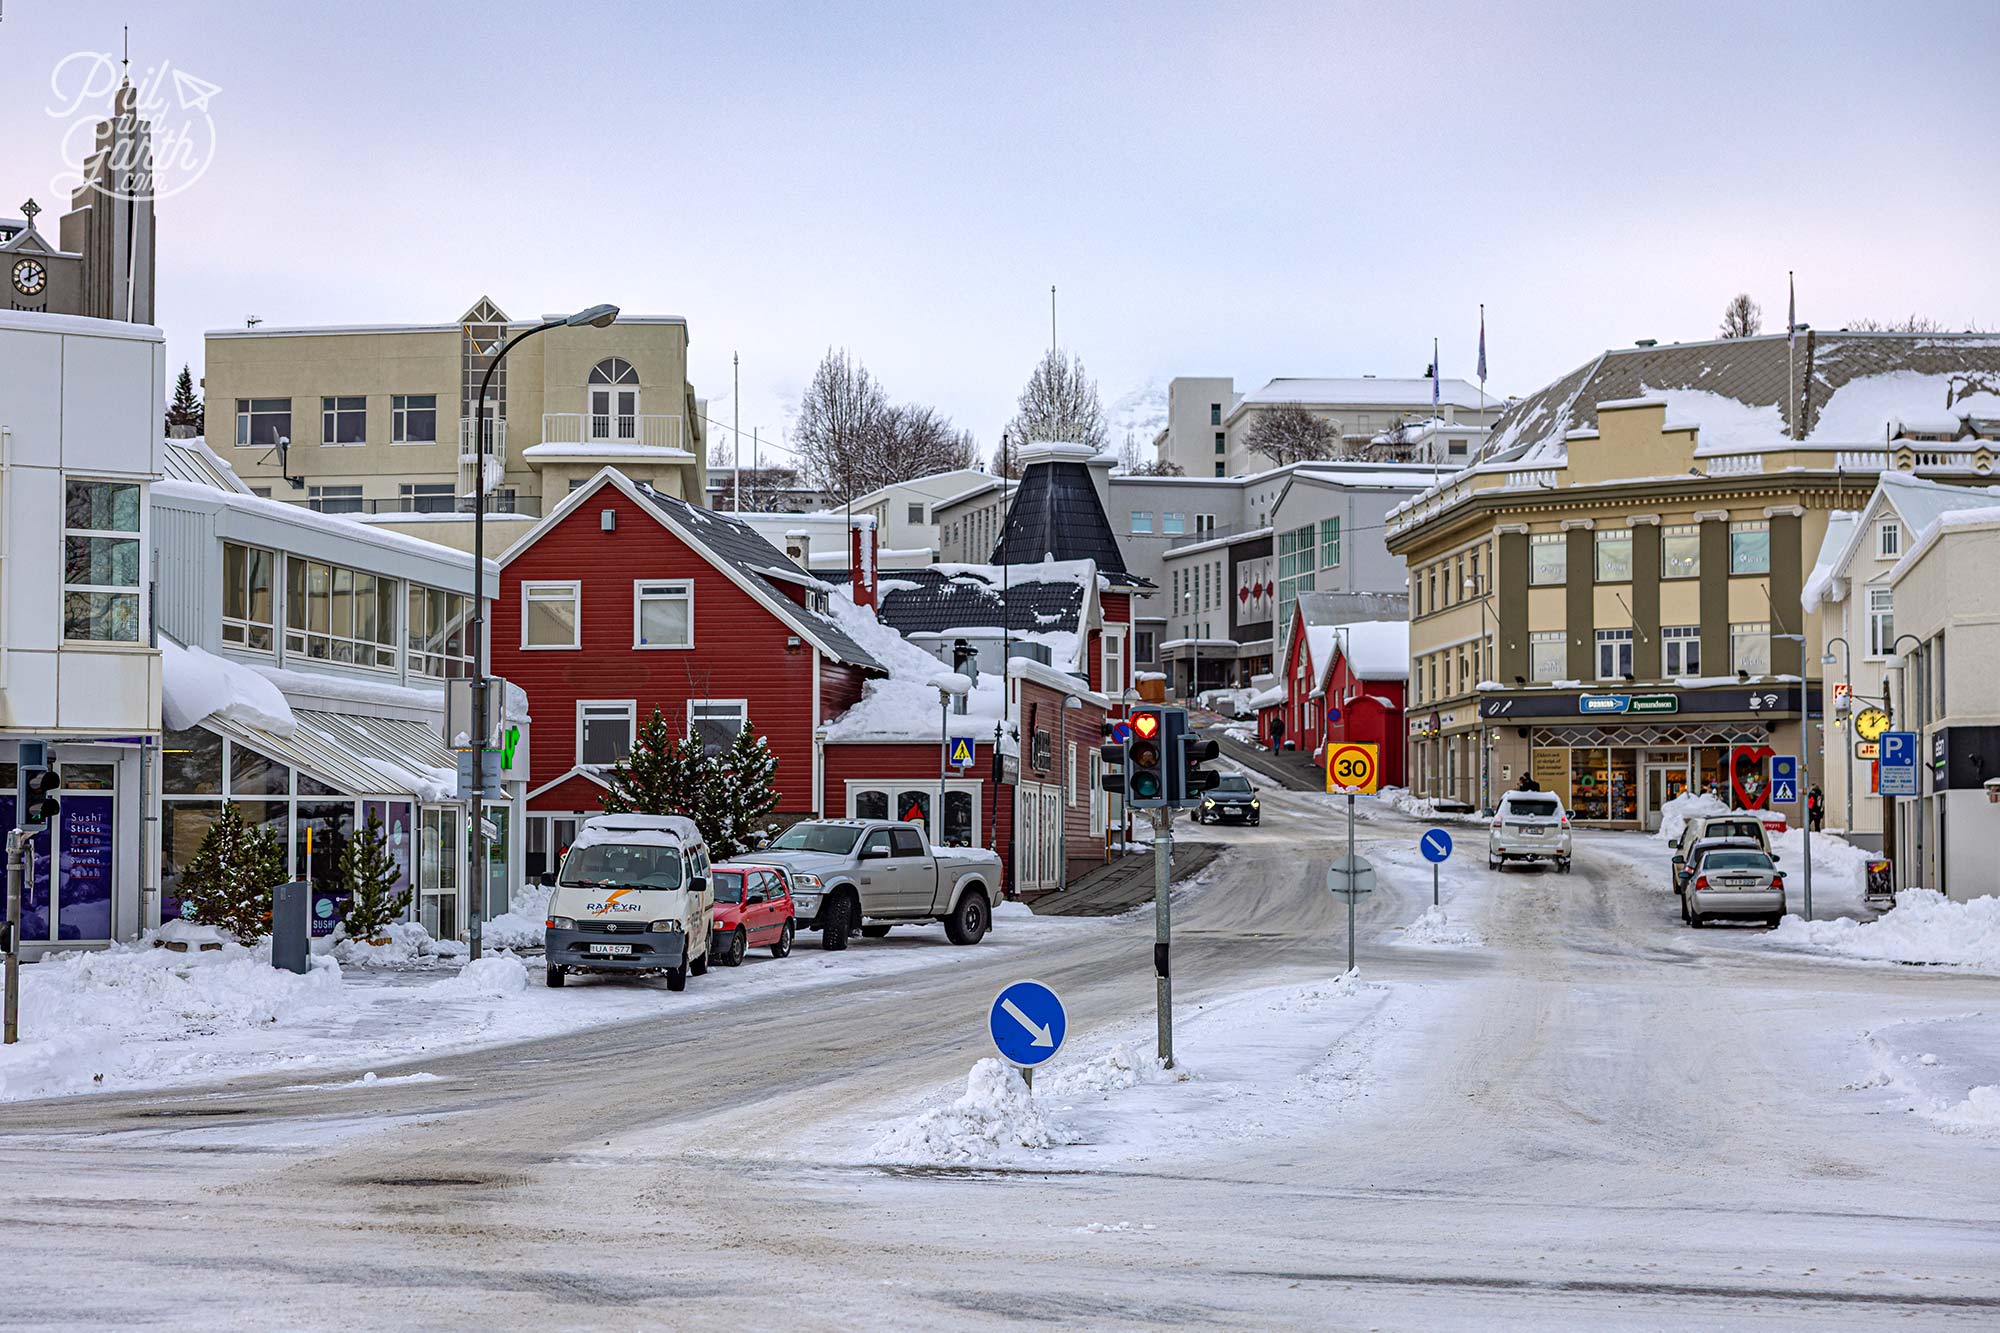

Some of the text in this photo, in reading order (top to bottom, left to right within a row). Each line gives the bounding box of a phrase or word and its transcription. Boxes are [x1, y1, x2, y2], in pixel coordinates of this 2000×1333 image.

[1886, 737, 1902, 758] P
[1338, 759, 1367, 778] 30
[72, 813, 102, 822] Sushi
[313, 920, 336, 928] SUSHI
